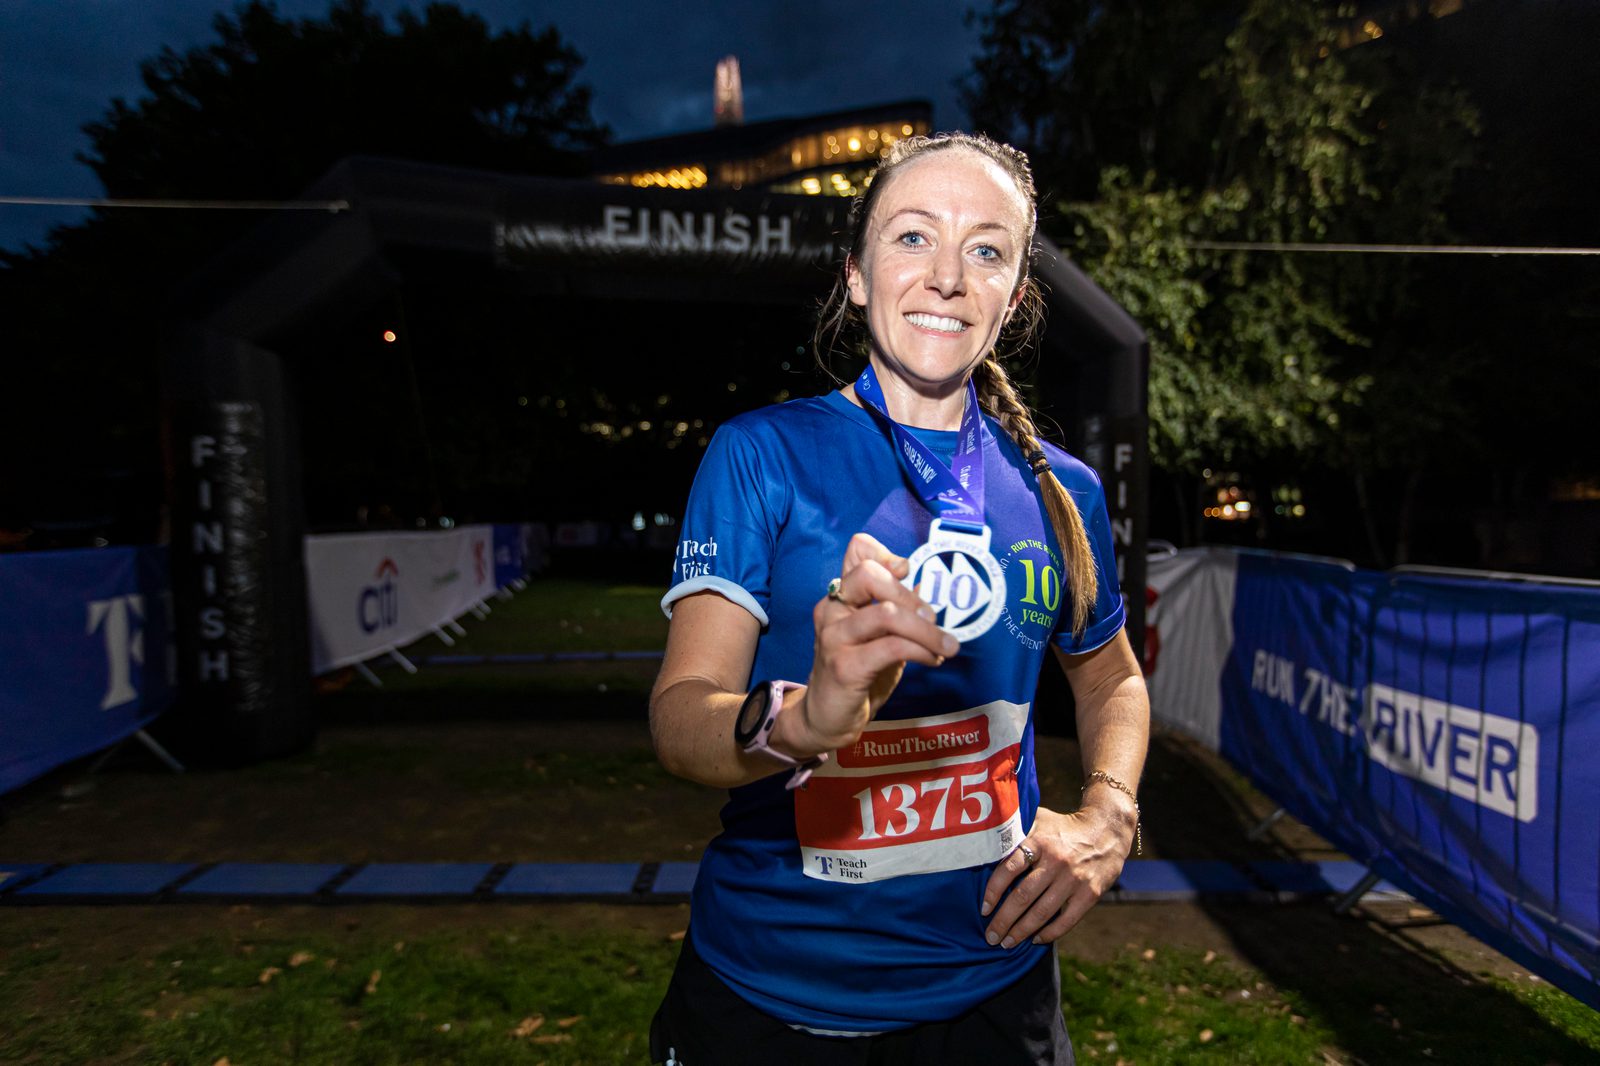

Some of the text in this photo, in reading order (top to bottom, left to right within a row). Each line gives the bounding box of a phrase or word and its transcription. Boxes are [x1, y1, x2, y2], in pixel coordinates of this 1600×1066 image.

[603, 205, 791, 253] FINISH
[190, 435, 230, 683] FINISH
[1010, 540, 1029, 553] RUN
[1027, 539, 1043, 550] THE
[930, 570, 978, 610] 10
[1018, 559, 1060, 611] 10
[1002, 614, 1020, 636] THE
[1020, 607, 1053, 629] years
[853, 729, 980, 758] #RunTheRiver
[1252, 649, 1516, 804] RUN THE RIVER
[852, 768, 993, 841] 1375
[836, 858, 867, 868] Teach
[839, 868, 864, 879] First
